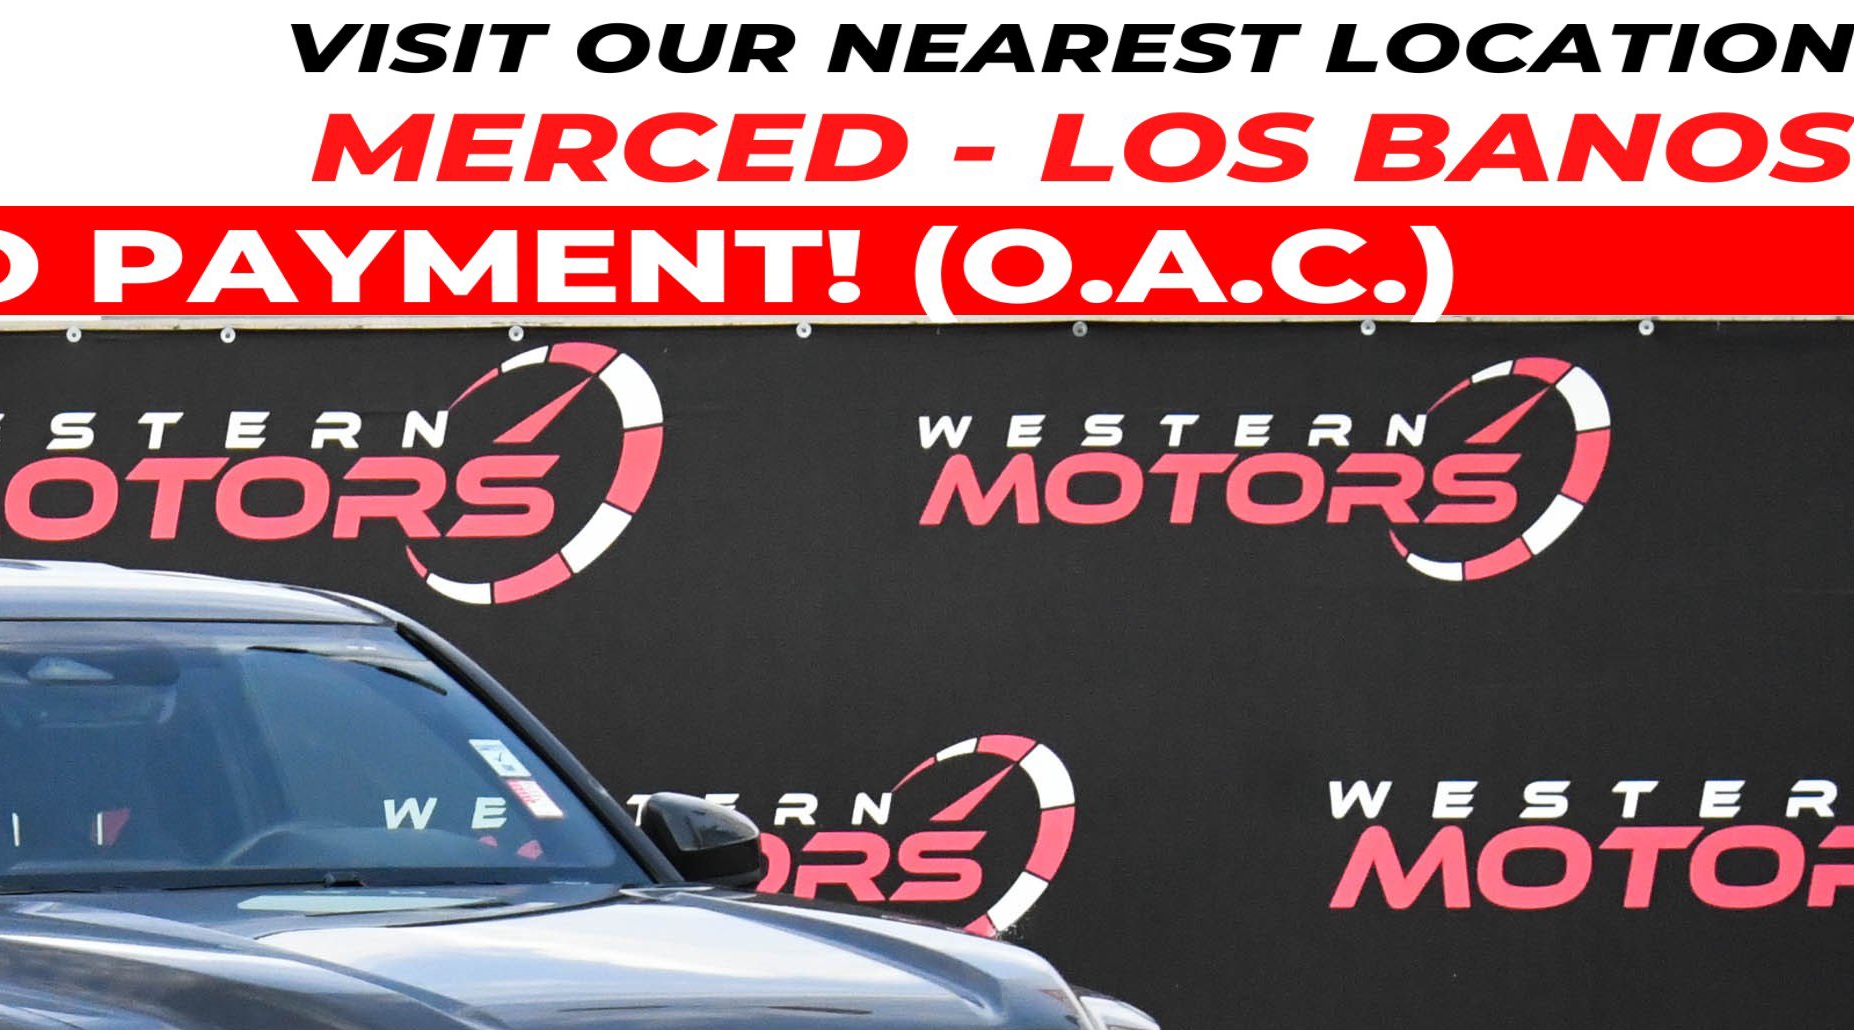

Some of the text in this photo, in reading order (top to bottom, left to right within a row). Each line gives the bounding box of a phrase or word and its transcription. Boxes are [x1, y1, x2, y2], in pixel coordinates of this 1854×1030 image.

[919, 414, 1426, 448] WESTERN
[920, 452, 1521, 526] MOTORS
[1330, 780, 1837, 818] WESTER
[1330, 825, 1854, 909] MOTO
